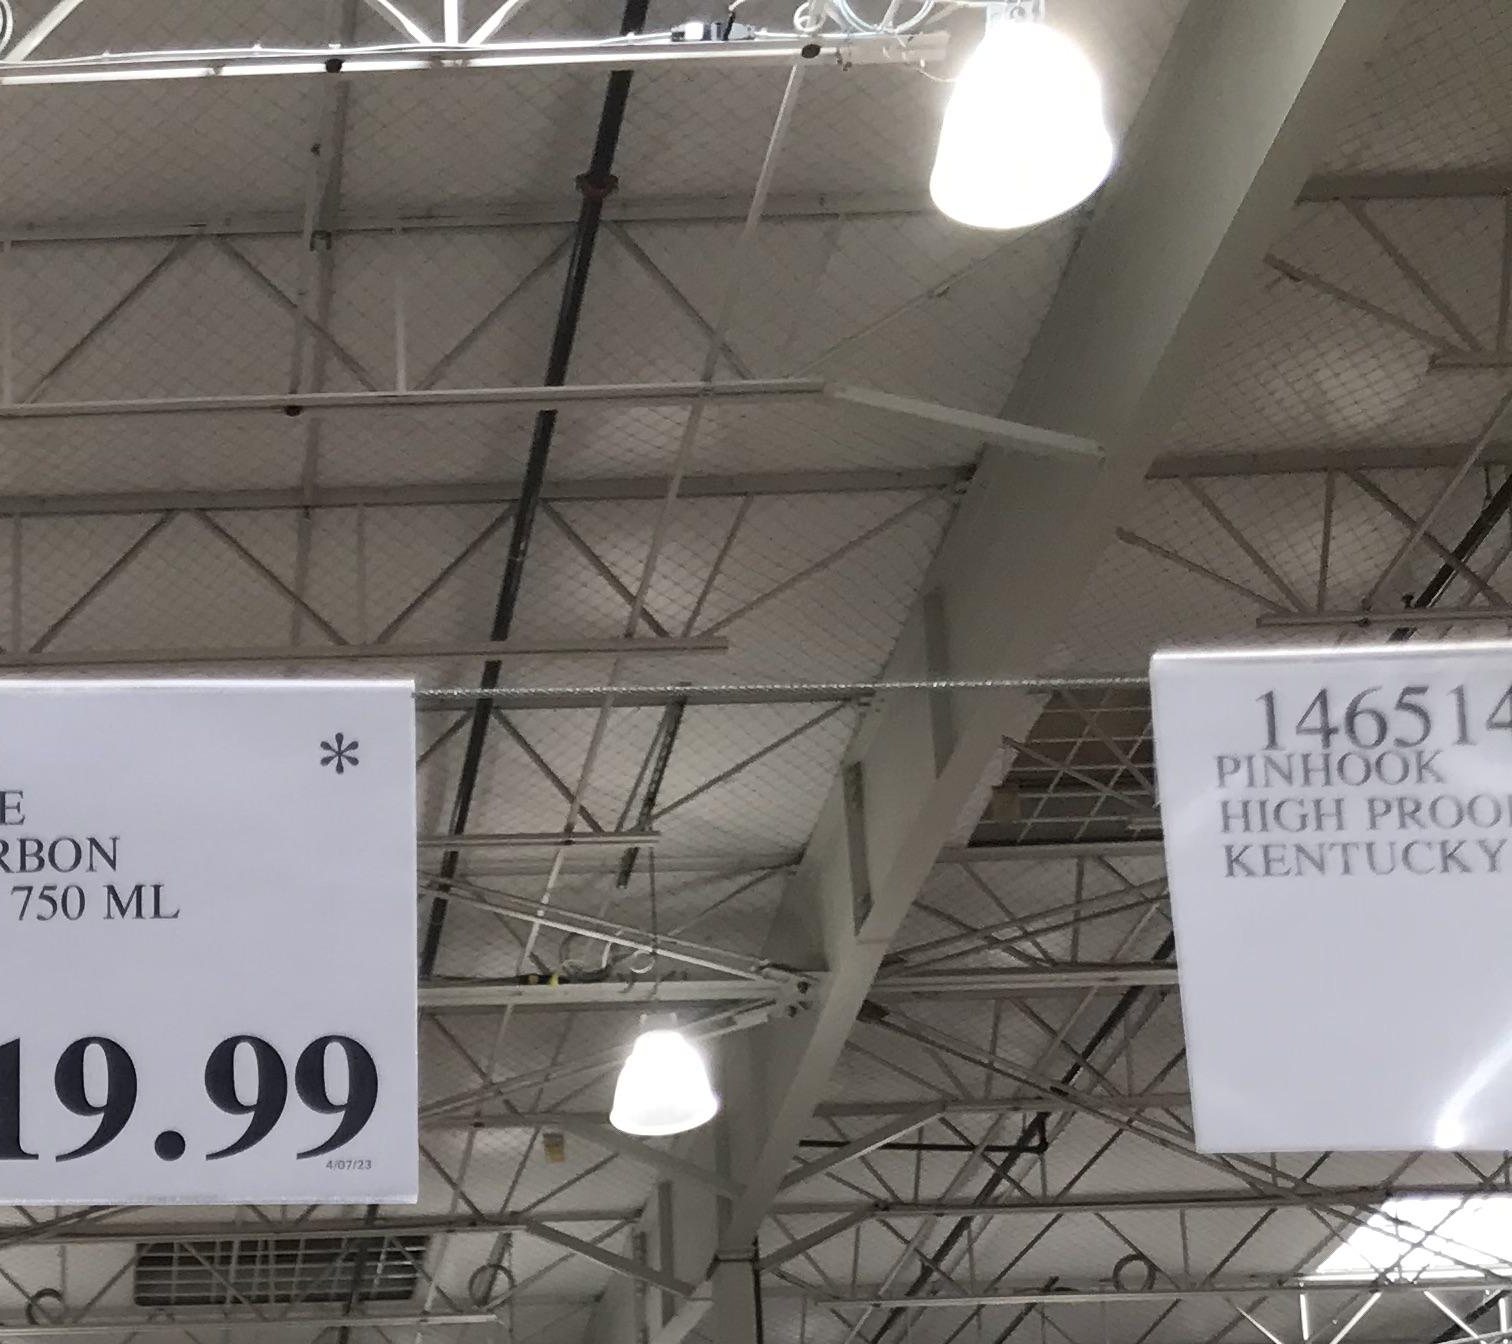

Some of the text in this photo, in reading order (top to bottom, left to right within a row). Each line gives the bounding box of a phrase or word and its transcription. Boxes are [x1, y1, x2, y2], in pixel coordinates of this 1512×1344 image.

[1214, 747, 1446, 789] PINHOOK
[1220, 794, 1512, 833] HIGH PROO
[1223, 838, 1508, 878] KENTUCKY
[10, 884, 87, 922] 750
[102, 883, 181, 921] ML
[325, 1160, 373, 1171] 4/07/23
